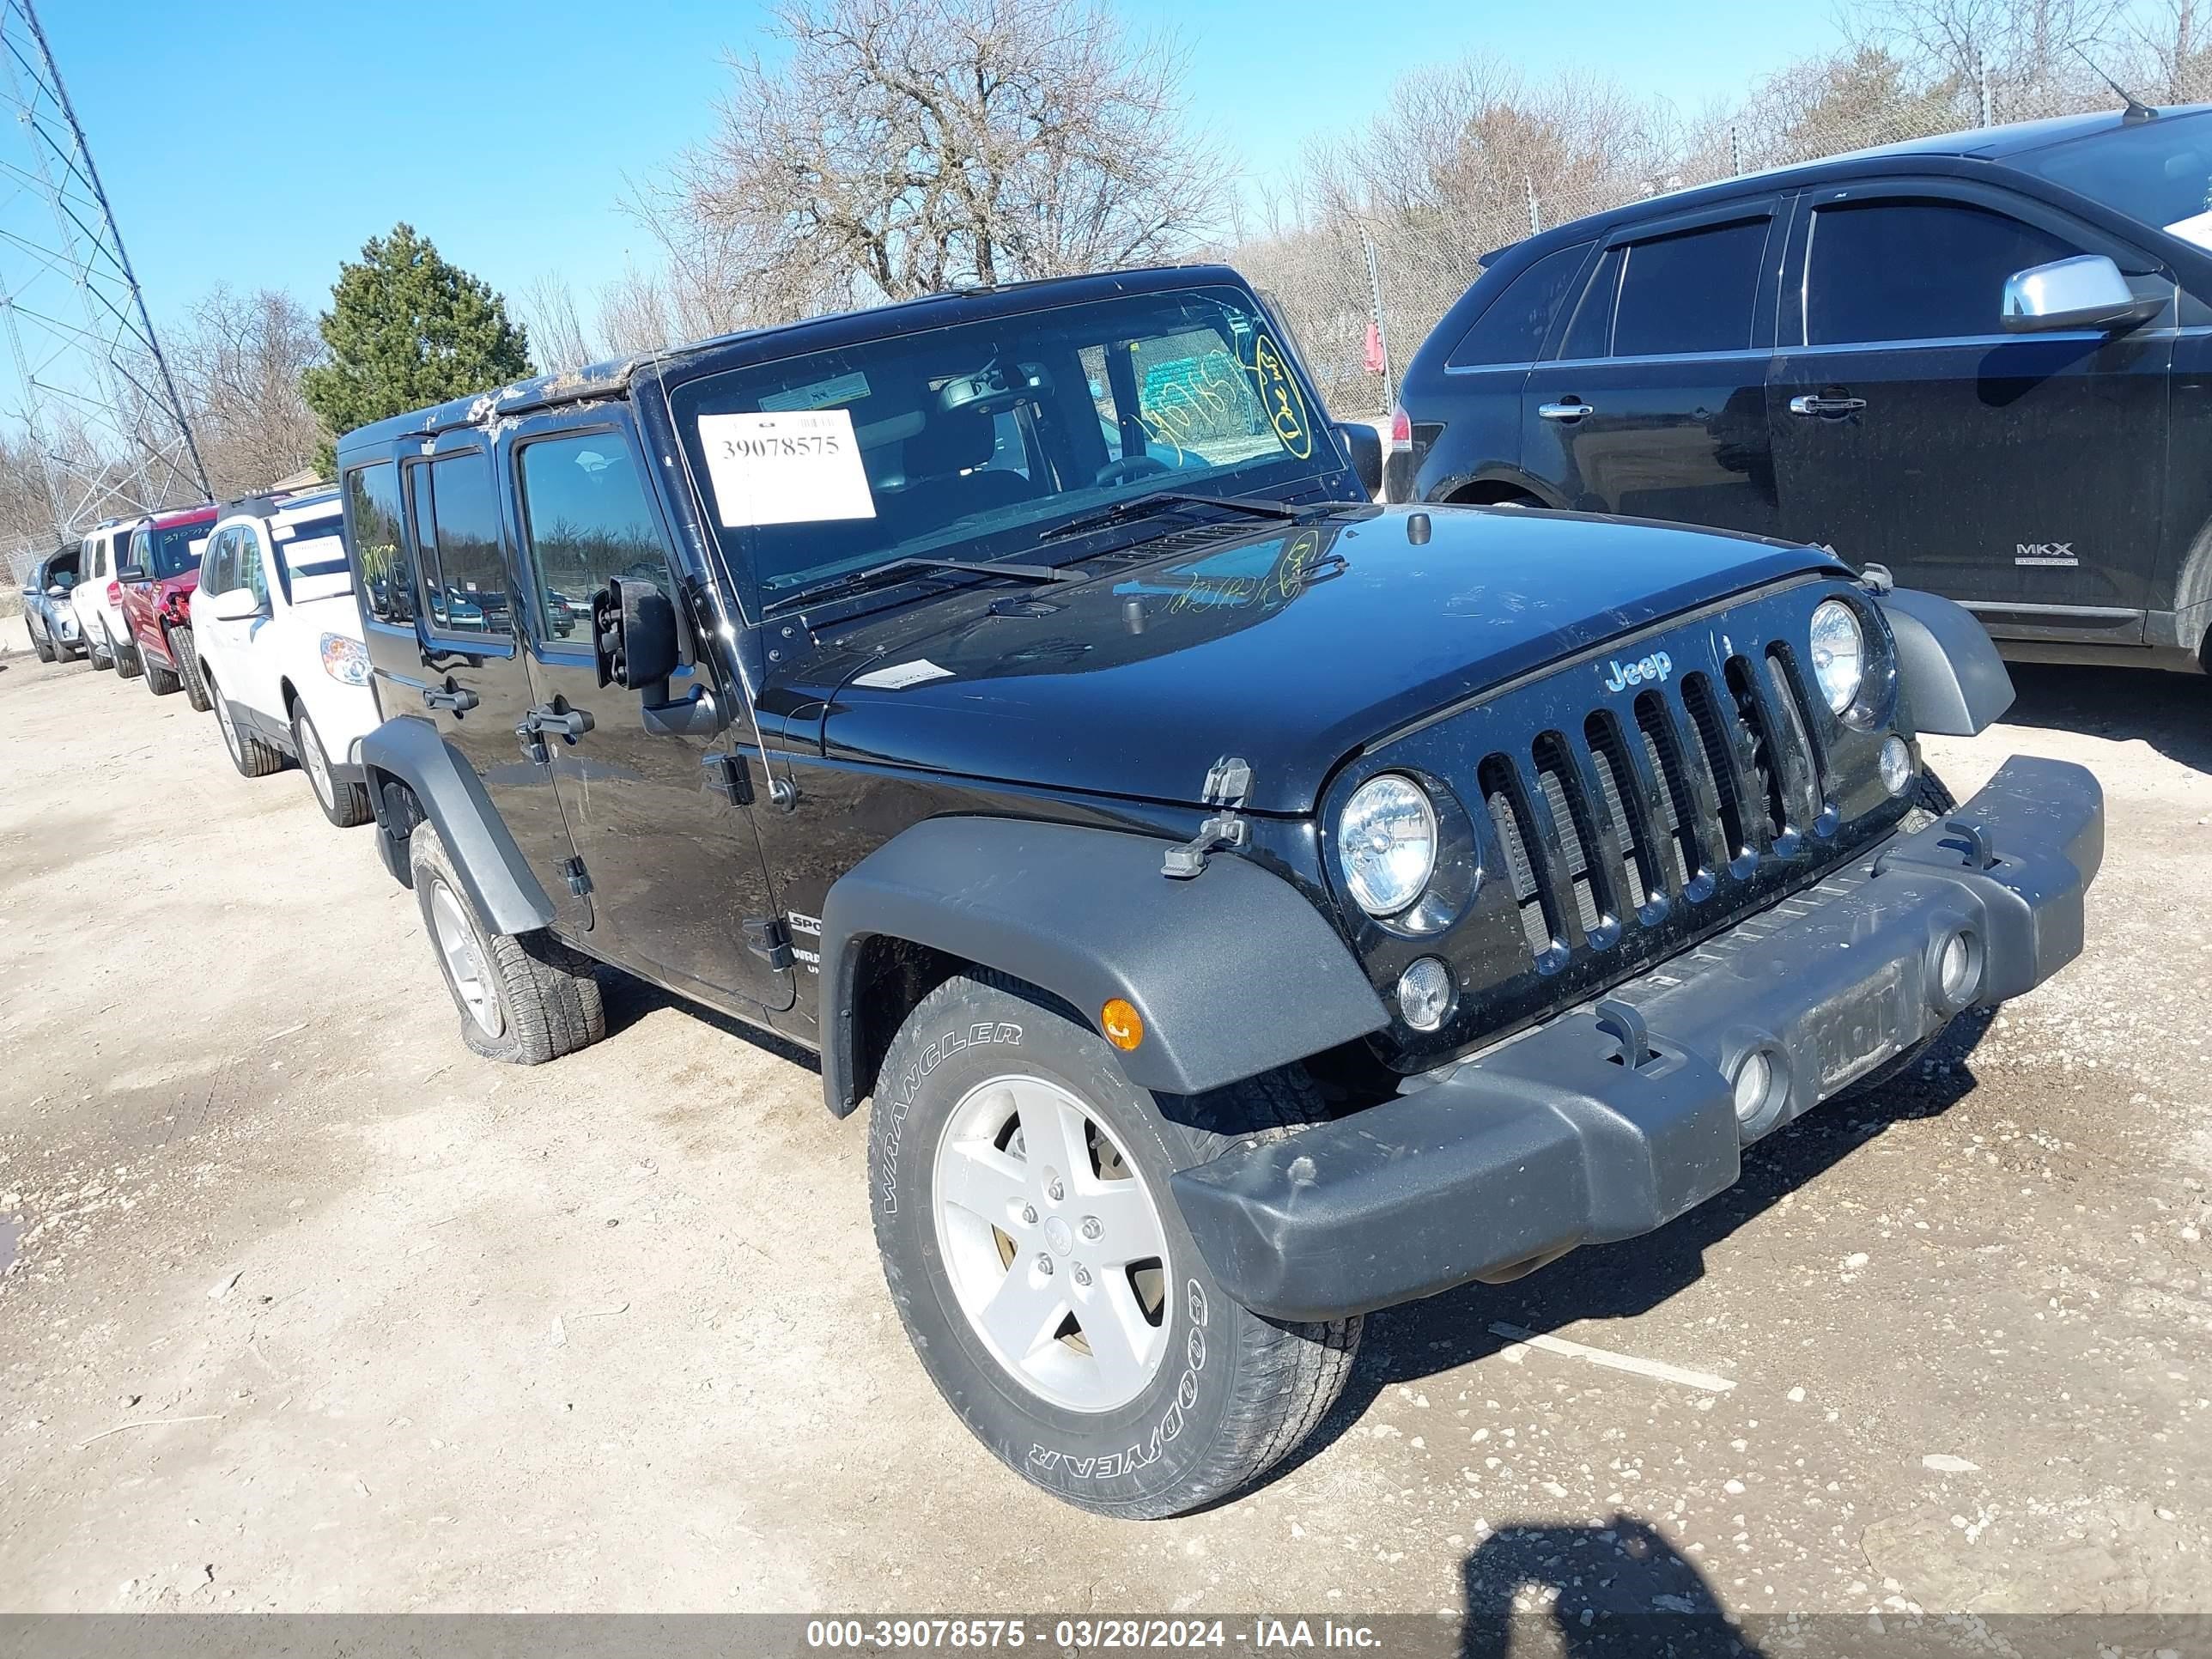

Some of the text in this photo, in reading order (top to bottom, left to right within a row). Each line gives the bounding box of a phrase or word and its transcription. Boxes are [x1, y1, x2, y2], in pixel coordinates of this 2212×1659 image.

[721, 436, 840, 460] 39078575
[2016, 542, 2075, 556] MKX
[1605, 651, 1673, 692] Jeep
[882, 1022, 1024, 1214] WRANGLER
[1030, 1278, 1209, 1479] GOODYEAR
